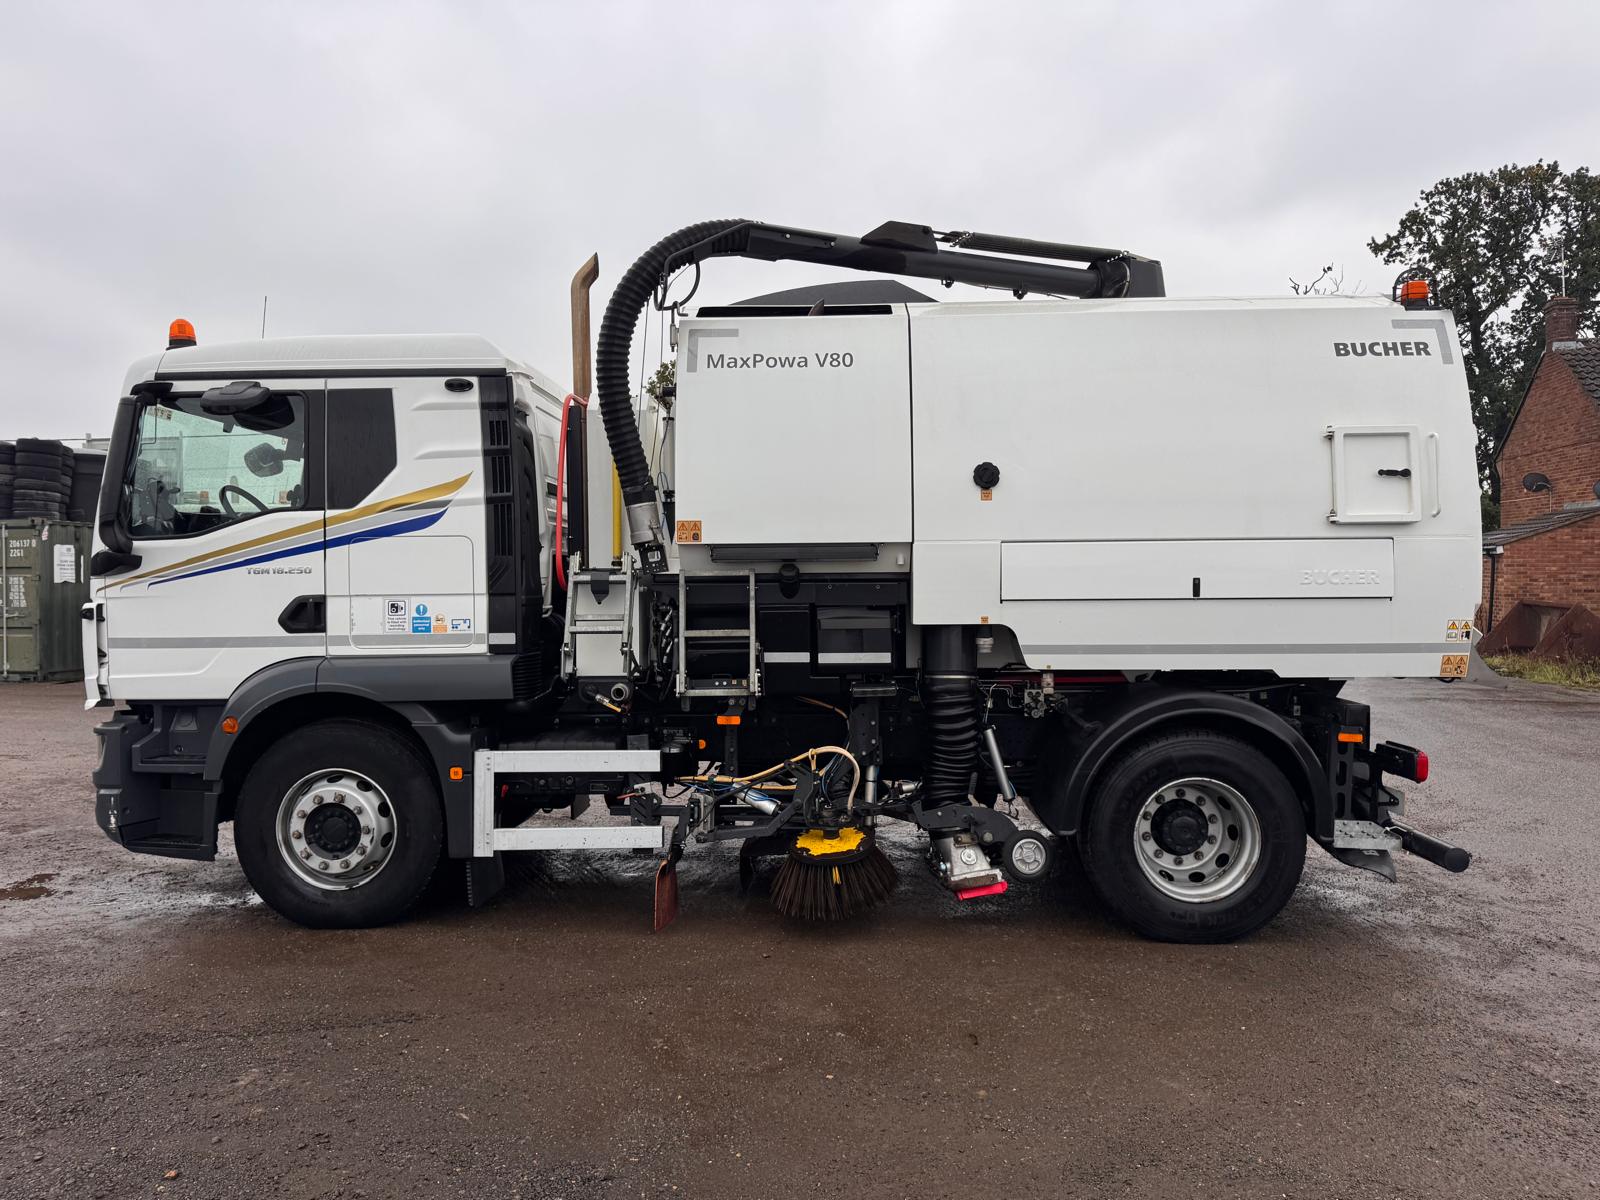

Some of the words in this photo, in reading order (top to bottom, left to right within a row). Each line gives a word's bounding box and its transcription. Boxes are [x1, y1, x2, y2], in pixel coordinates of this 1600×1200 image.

[1334, 342, 1432, 357] BUCHER
[706, 353, 809, 369] MaxPowa
[815, 352, 854, 368] V80
[1300, 569, 1380, 586] BUCHER
